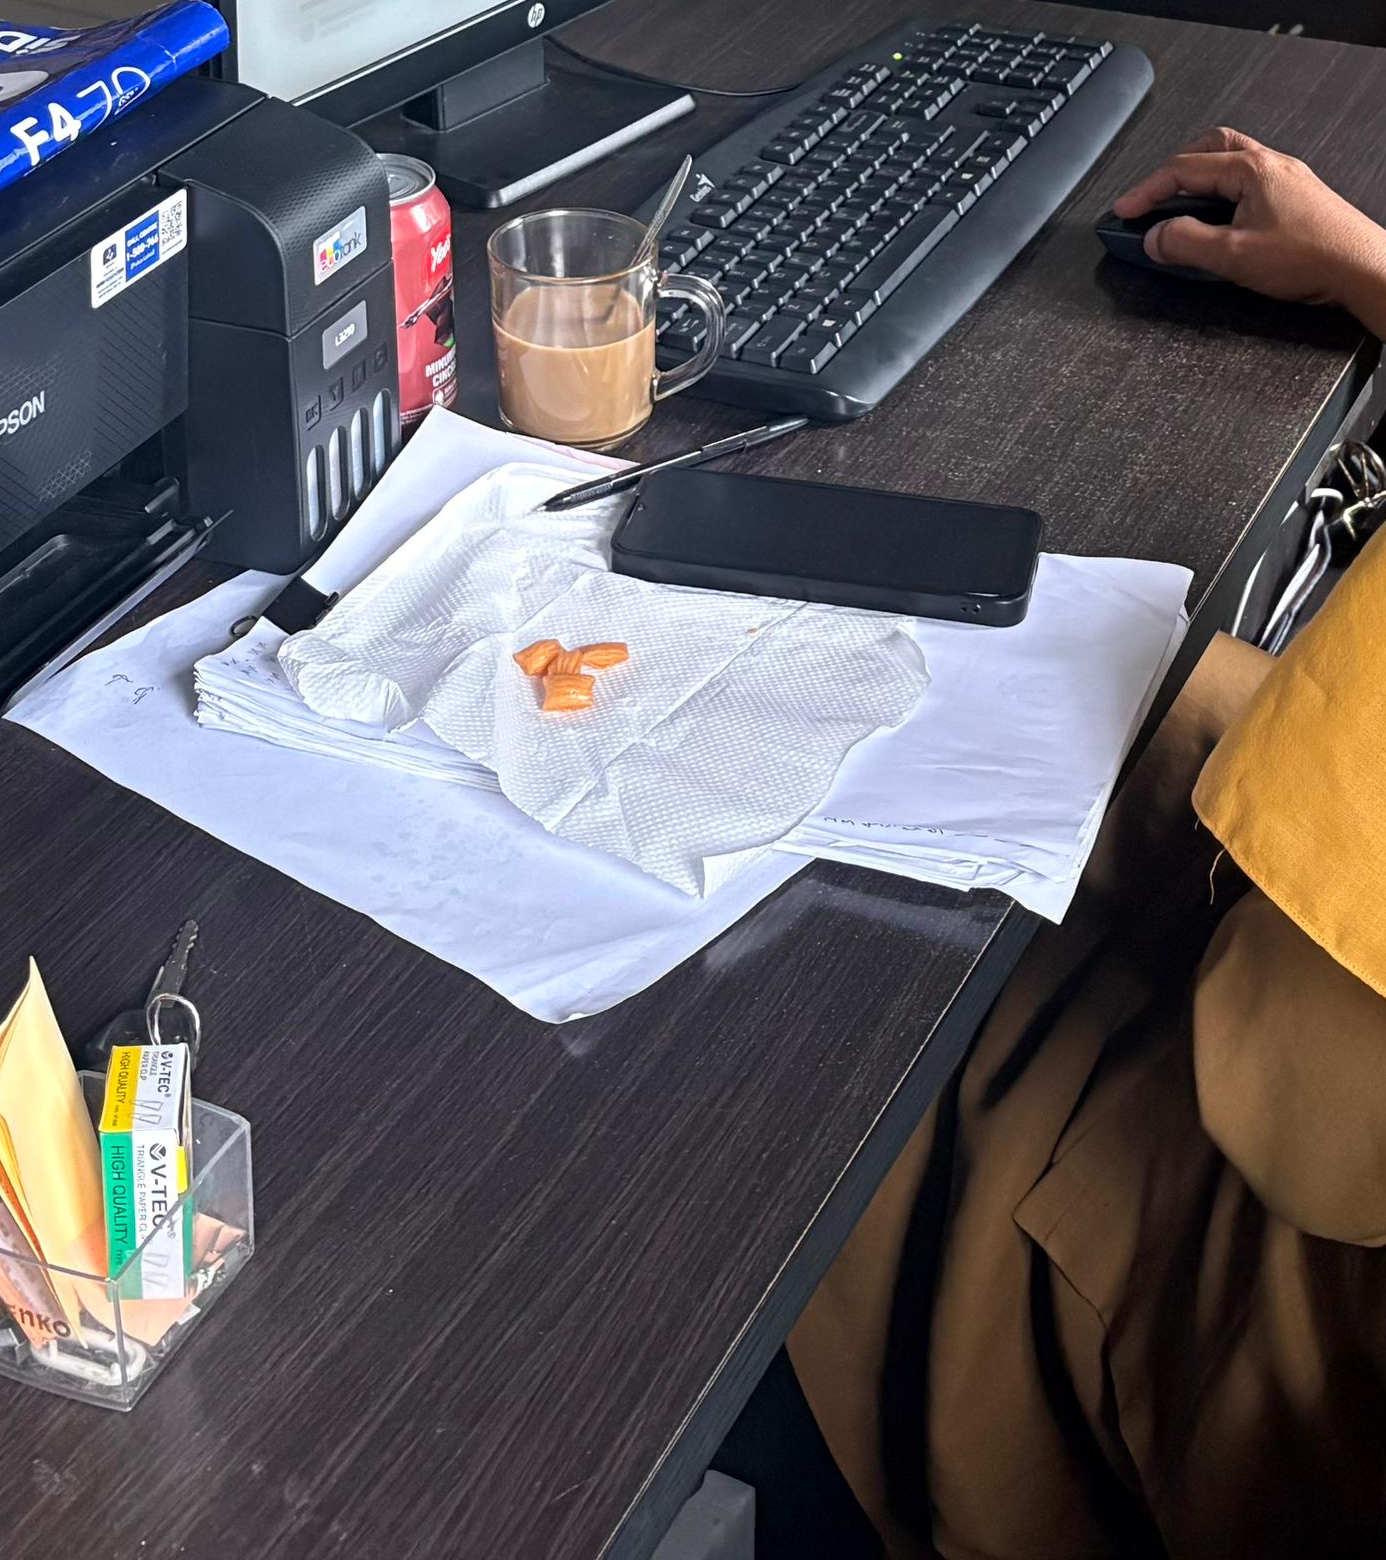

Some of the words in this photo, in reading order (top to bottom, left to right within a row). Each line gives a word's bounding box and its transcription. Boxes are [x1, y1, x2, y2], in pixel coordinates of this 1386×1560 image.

[528, 2, 545, 28] hp
[10, 102, 82, 166] F4
[111, 1145, 125, 1181] HIGH
[136, 1145, 147, 1188] TRIANGLE
[113, 1185, 128, 1244] QUALITY
[138, 1191, 147, 1221] PAPER
